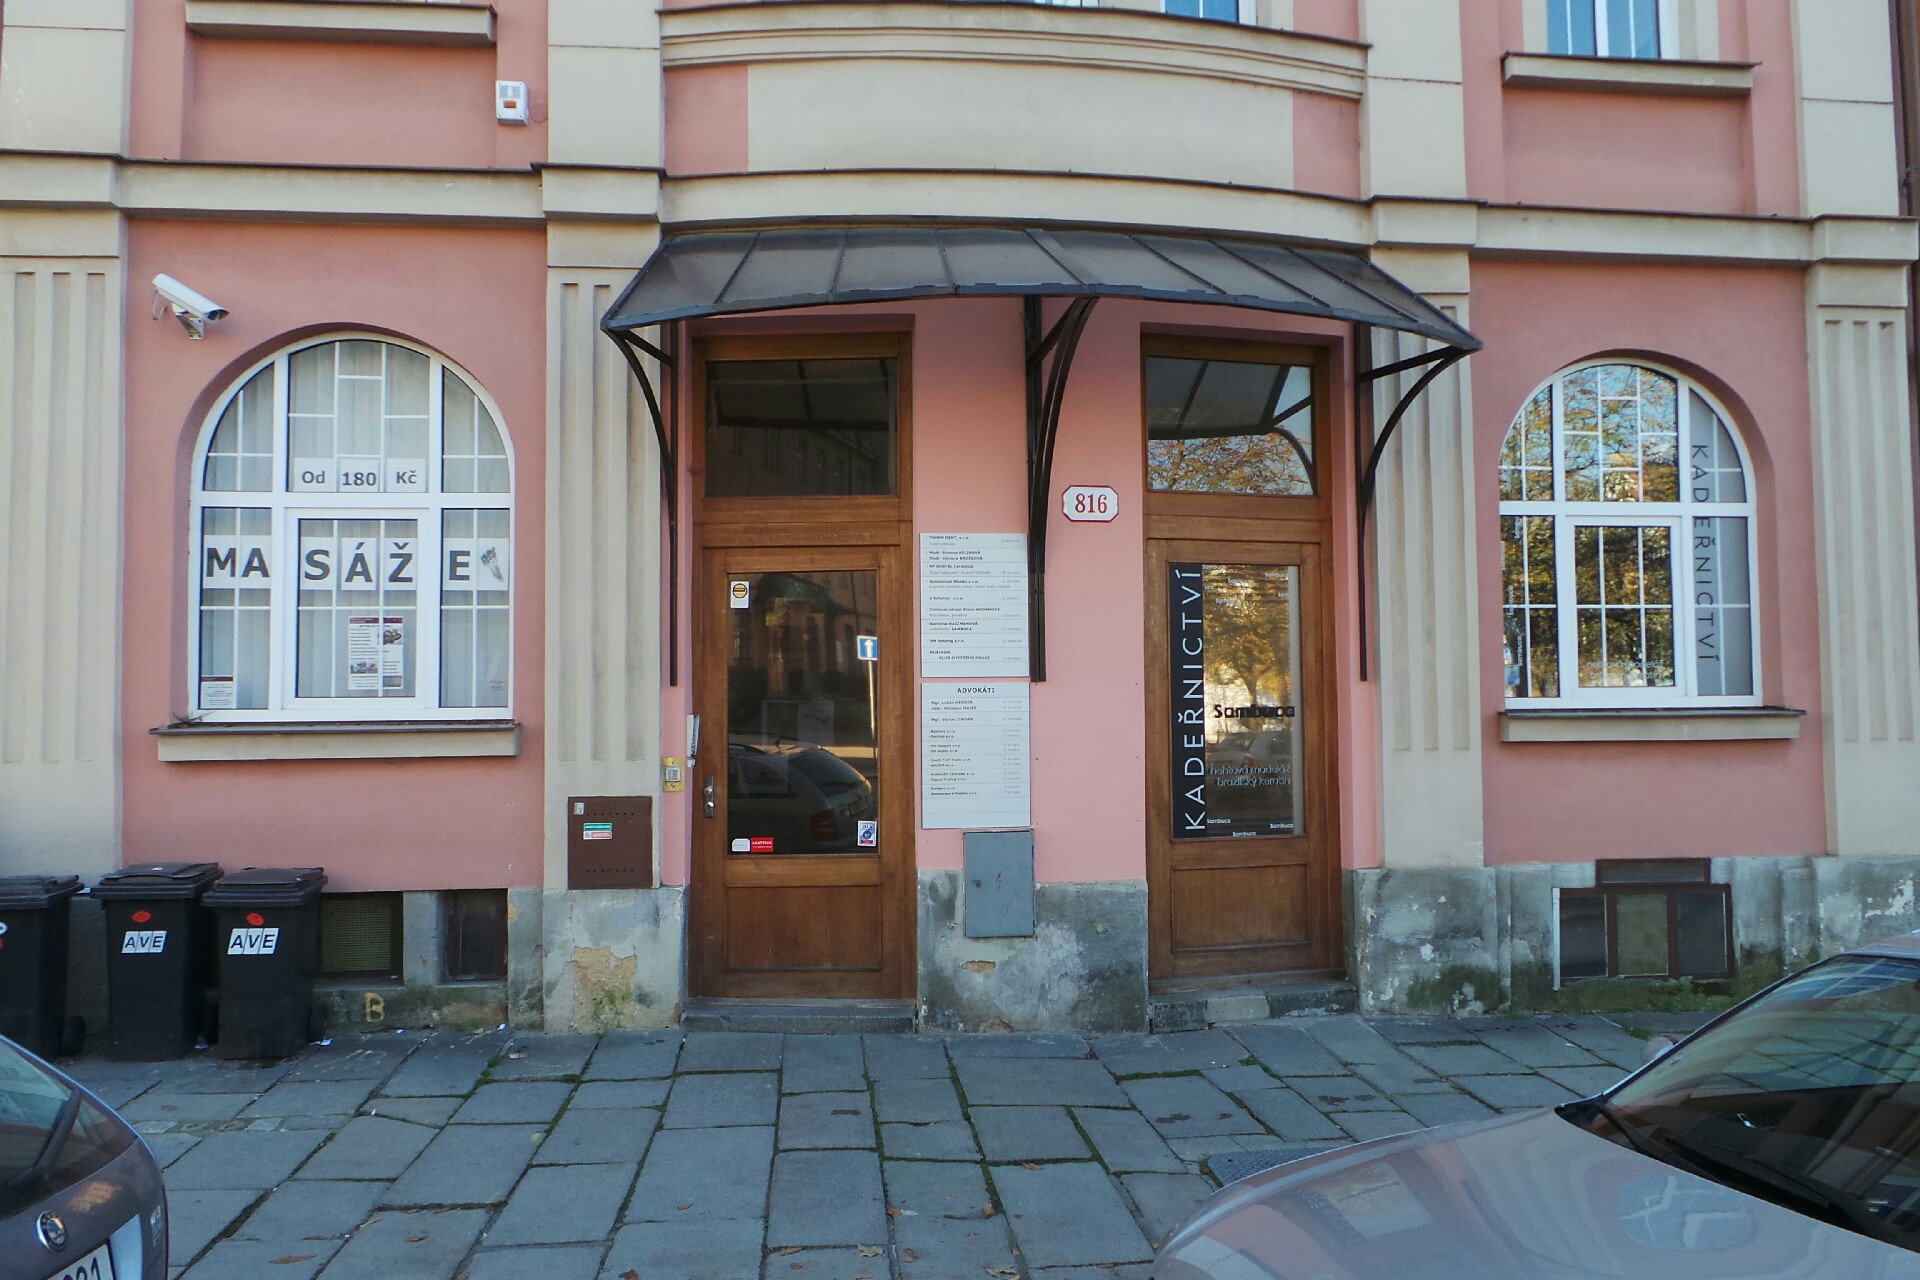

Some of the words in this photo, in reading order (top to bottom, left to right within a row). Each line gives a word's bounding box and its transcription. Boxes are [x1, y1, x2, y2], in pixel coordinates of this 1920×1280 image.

[301, 471, 326, 484] Od
[342, 472, 377, 486] 180
[396, 470, 418, 484] Kč
[1074, 493, 1108, 514] 816
[206, 542, 471, 583] MASÁŽE
[1692, 444, 1720, 663] KADEŘNICTVÍ
[1174, 569, 1206, 830] KADEŘNICTVÍ
[124, 935, 163, 949] AVE
[230, 934, 277, 949] AVE
